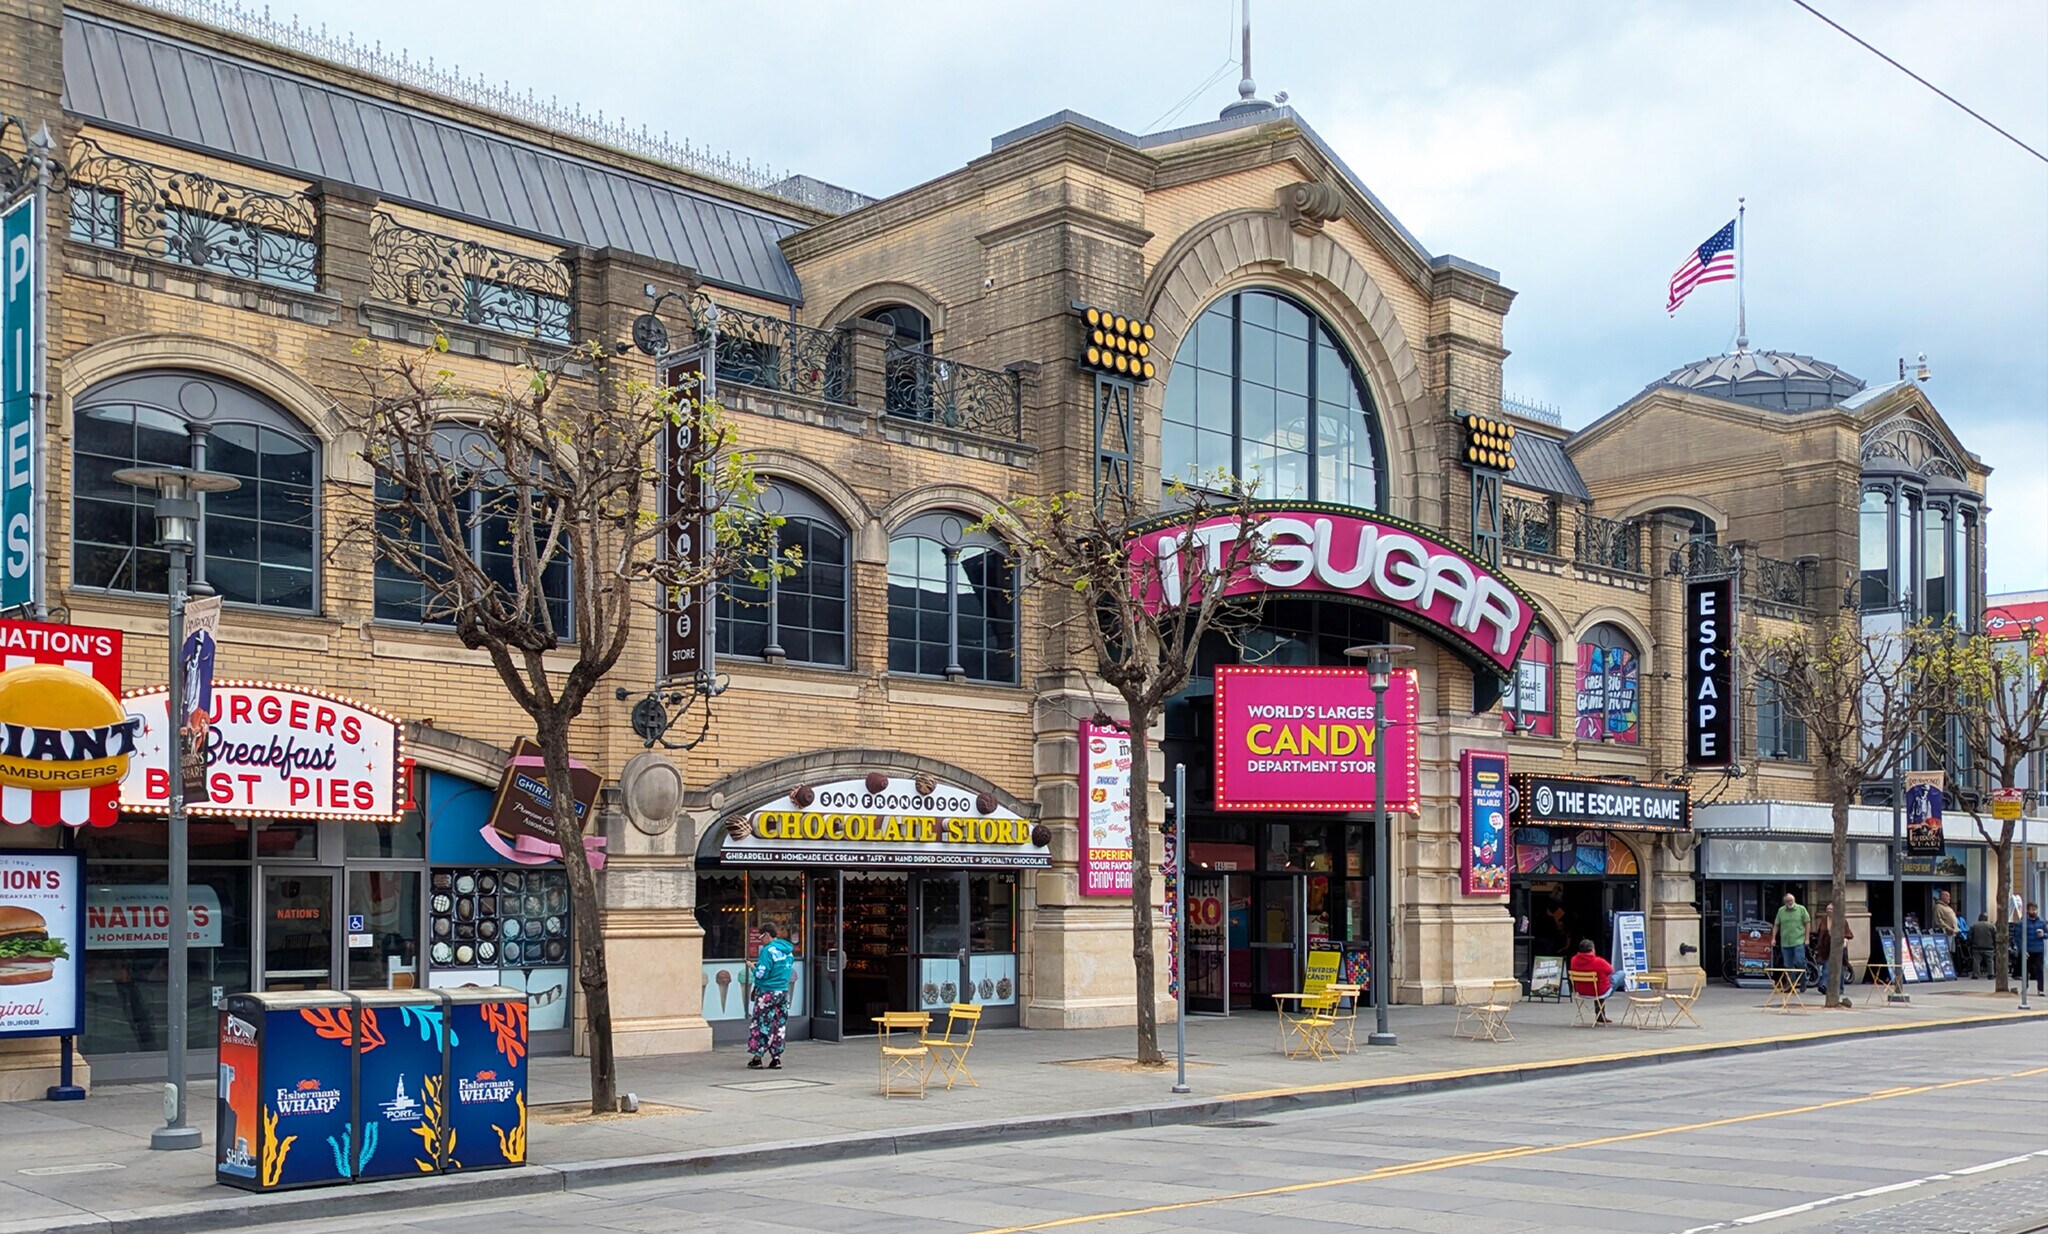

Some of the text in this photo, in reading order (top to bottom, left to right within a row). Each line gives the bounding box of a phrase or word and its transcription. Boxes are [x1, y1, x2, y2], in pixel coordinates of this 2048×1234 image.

[8, 233, 31, 582] PIES
[672, 649, 695, 661] STORE
[1698, 591, 1718, 757] ESCAPE
[1520, 680, 1542, 692] SCAPE
[1520, 692, 1535, 702] AME
[1608, 690, 1633, 710] HOW
[1248, 705, 1376, 719] WORLD'S LARGES
[166, 695, 361, 745] URGERS
[1246, 723, 1376, 756] CANDY
[206, 726, 337, 780] Breakfast
[1248, 760, 1376, 773] DEPARTMENT STOR
[146, 768, 374, 811] BST PIES
[820, 792, 971, 812] SAN FRANCISCO
[1556, 791, 1680, 820] THE ESCAPE GAME
[758, 812, 1031, 845] CHOCOLATE STORE
[726, 852, 773, 861] GHIRARDELLI
[781, 853, 821, 861] HOMEMADE
[823, 853, 833, 861] ICE
[835, 854, 858, 862] CREAM
[867, 854, 886, 862] TAFFY
[937, 856, 973, 864] CHOCOLATE
[1089, 849, 1132, 861] EXPERIEN
[1089, 861, 1110, 870] YOUR
[0, 870, 60, 890] ION'S
[1089, 871, 1113, 889] CANDY
[88, 905, 209, 928] NATIO'S
[277, 909, 320, 919] NATION'S
[97, 932, 200, 941] HOMEMADE ES
[1306, 973, 1331, 981] CANDY!
[1307, 966, 1337, 974] SWEDISH
[223, 1035, 232, 1043] SAN
[459, 1079, 514, 1090] Fisherman's
[277, 1088, 340, 1100] Fisherman's
[459, 1087, 514, 1102] WHARF
[277, 1097, 340, 1113] WHARF
[386, 1110, 413, 1119] PORT
[226, 1148, 249, 1167] SHIPS
